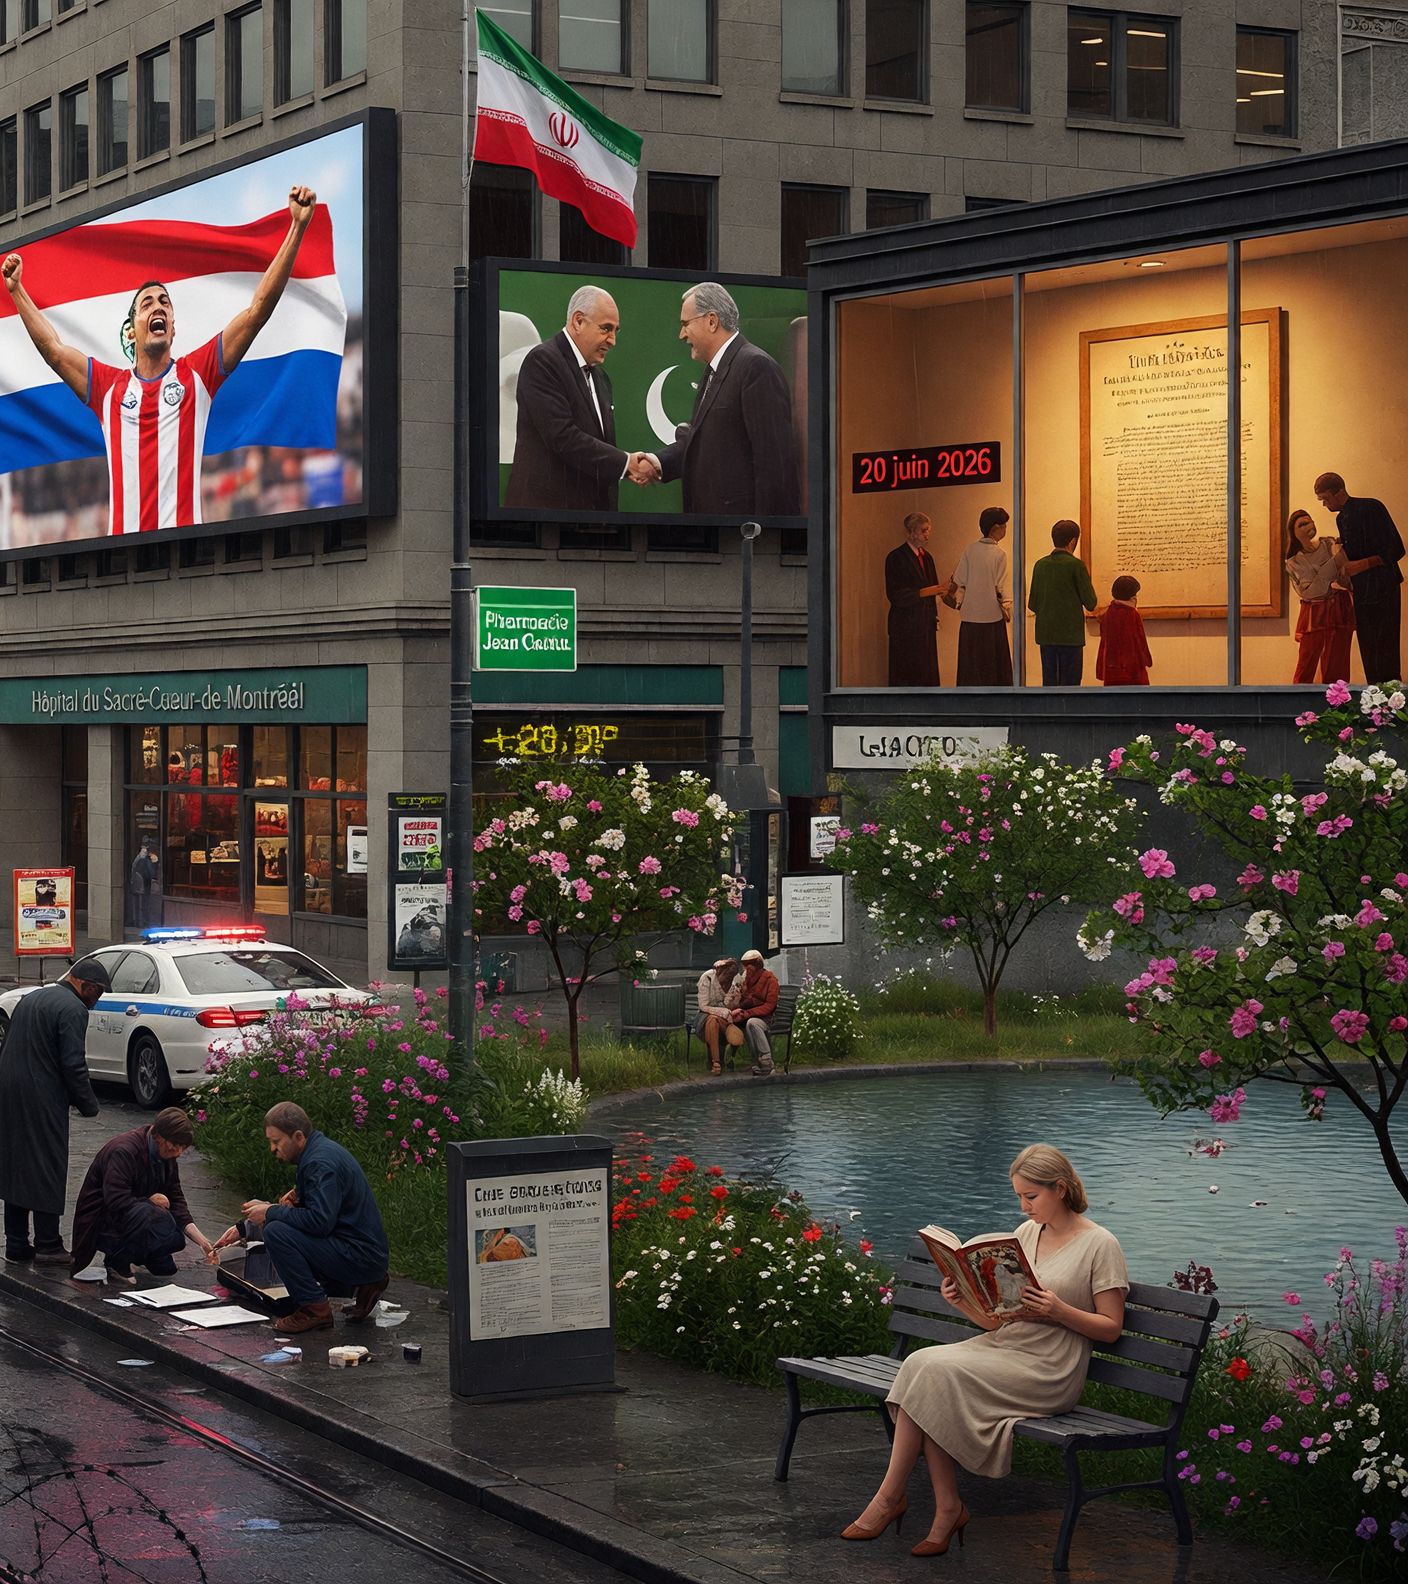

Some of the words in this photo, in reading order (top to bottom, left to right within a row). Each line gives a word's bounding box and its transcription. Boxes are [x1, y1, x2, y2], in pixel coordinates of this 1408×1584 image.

[860, 457, 886, 484] 20
[891, 454, 929, 488] juin
[937, 447, 991, 478] 2026
[83, 687, 99, 712] du
